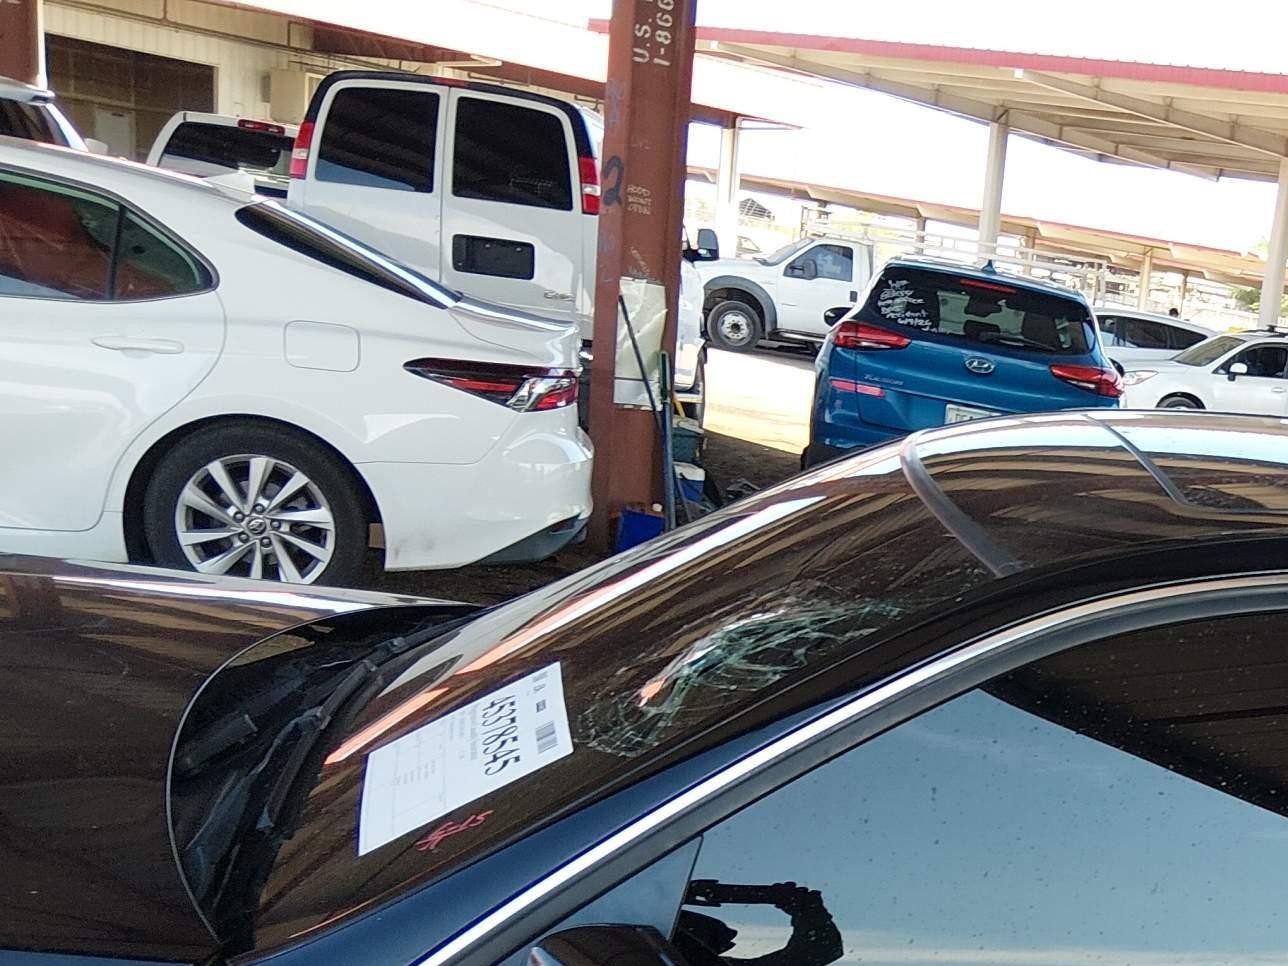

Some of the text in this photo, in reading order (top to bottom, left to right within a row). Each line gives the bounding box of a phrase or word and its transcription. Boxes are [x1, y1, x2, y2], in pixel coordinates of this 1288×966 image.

[633, 18, 652, 63] U.S.
[602, 155, 625, 206] 2
[482, 695, 521, 776] 45378545
